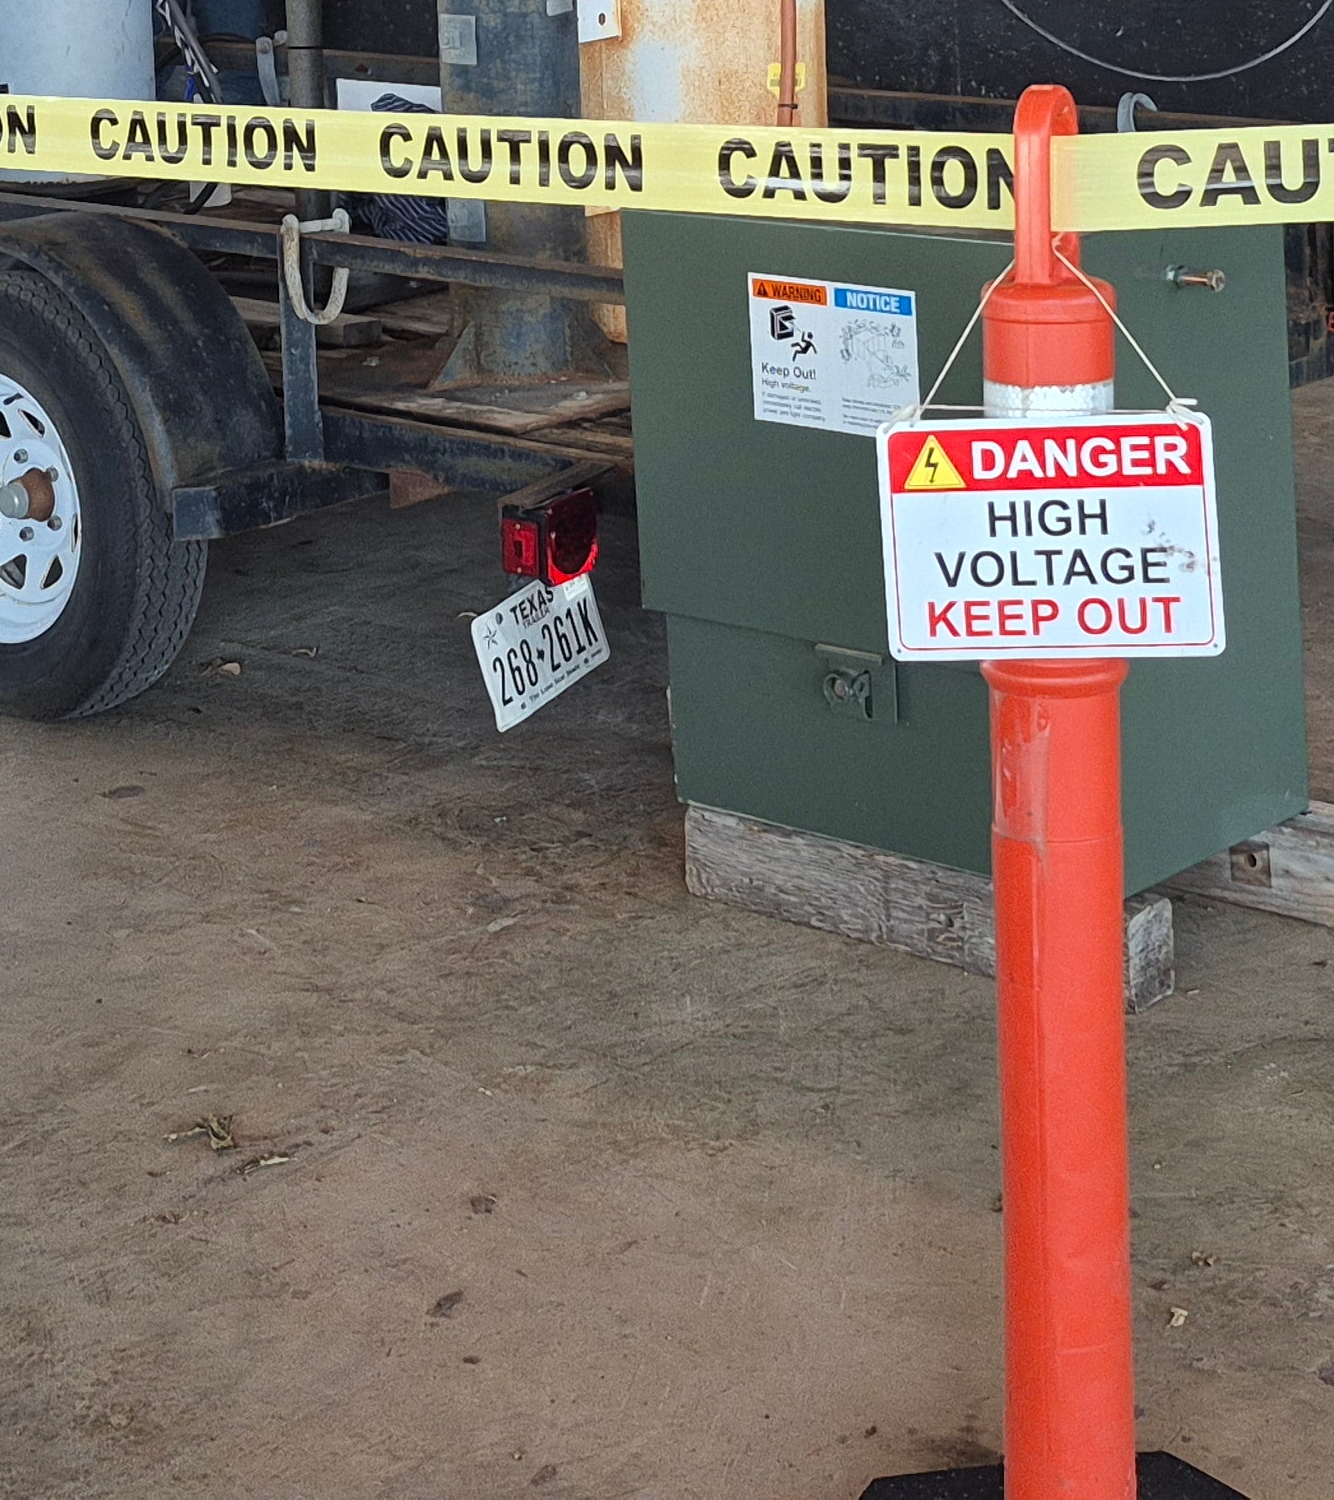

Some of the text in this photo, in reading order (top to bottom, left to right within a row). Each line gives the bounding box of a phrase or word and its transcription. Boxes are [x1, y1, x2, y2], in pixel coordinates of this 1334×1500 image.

[89, 108, 316, 173] CAUTION
[379, 122, 644, 193] CAUTION
[771, 283, 822, 303] WARNING
[846, 290, 900, 313] NOTICE
[761, 361, 790, 379] Keep
[971, 435, 1192, 481] DANGER
[987, 498, 1109, 538] HIGH
[934, 547, 1171, 588] VOLTAGE
[510, 588, 554, 626] TEXAS
[927, 596, 1182, 638] KEEP OUT
